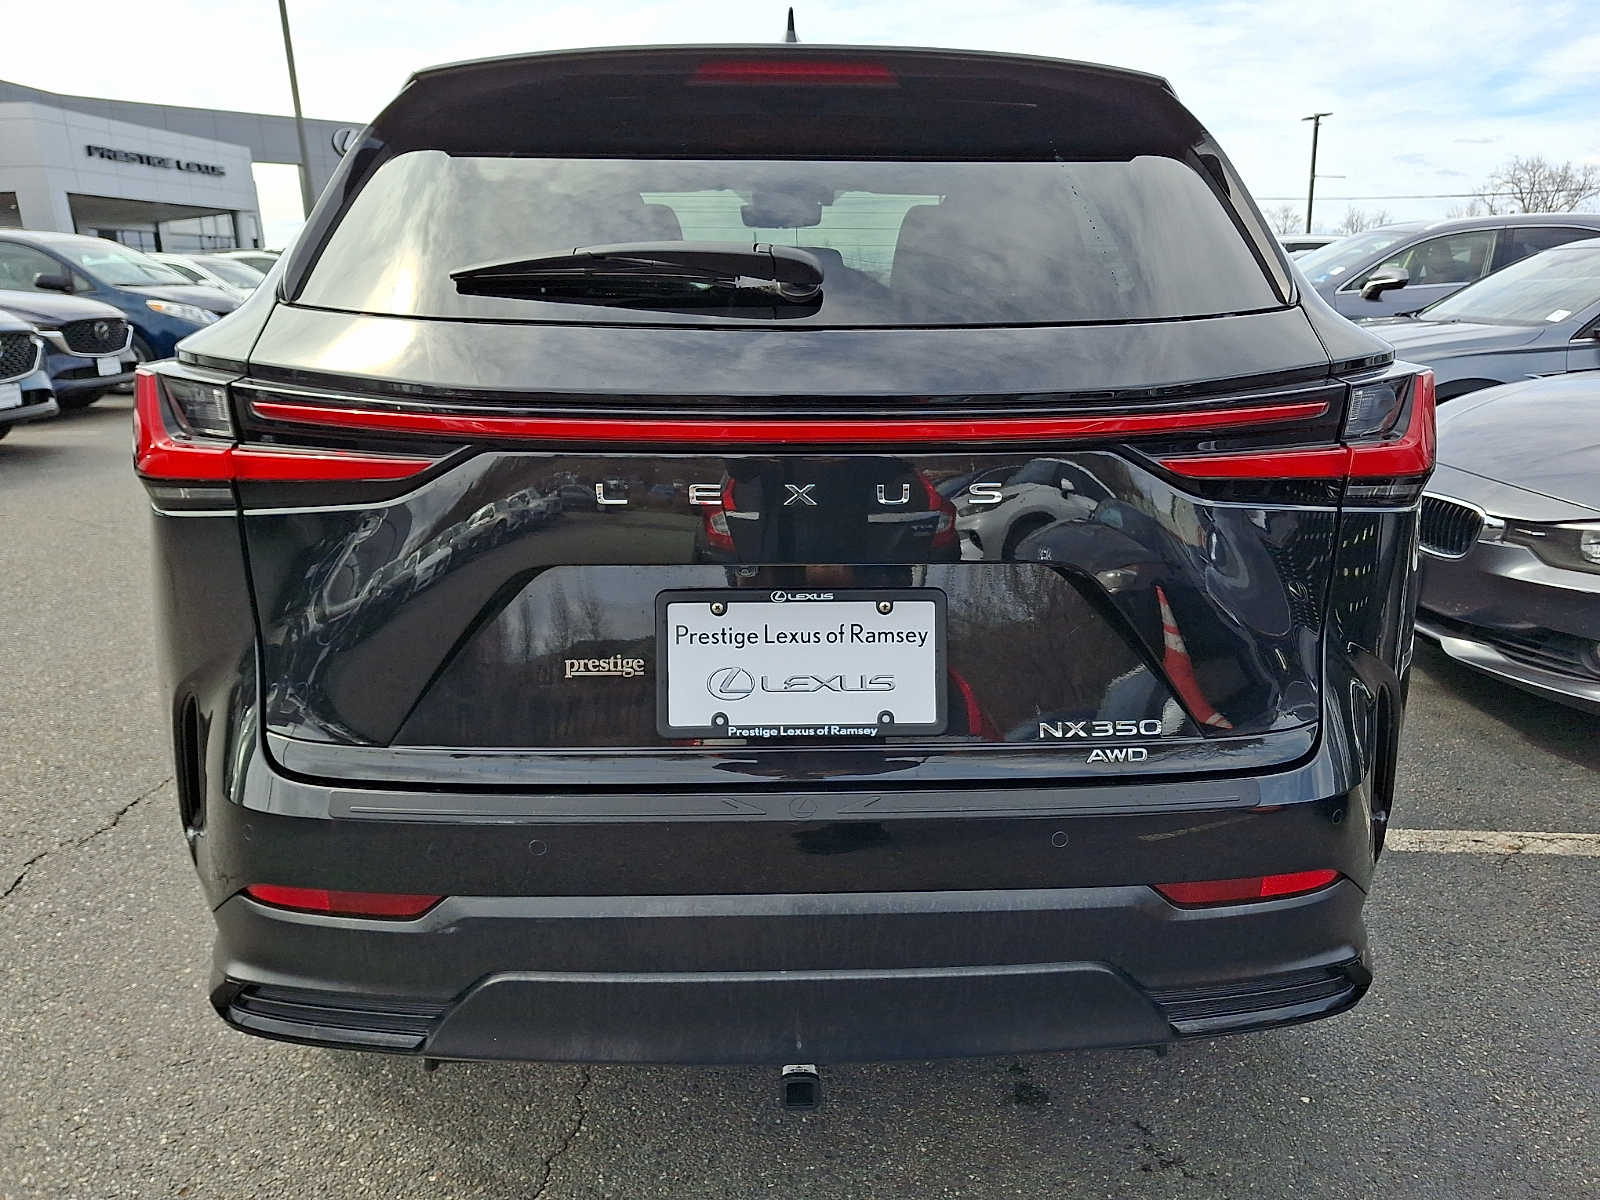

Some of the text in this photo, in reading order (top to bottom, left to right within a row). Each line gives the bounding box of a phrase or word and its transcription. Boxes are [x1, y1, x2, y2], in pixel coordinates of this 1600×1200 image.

[85, 145, 225, 176] PRESTIGE LEXUS
[595, 483, 1003, 506] LEXUS
[787, 592, 834, 601] LEXUS
[675, 623, 929, 649] Prestige Lexus of Ramsey
[564, 654, 645, 679] prestige
[760, 674, 896, 693] LEXUS
[728, 725, 878, 737] Prestige Lexus of Ramsey
[1086, 747, 1148, 764] AWD
